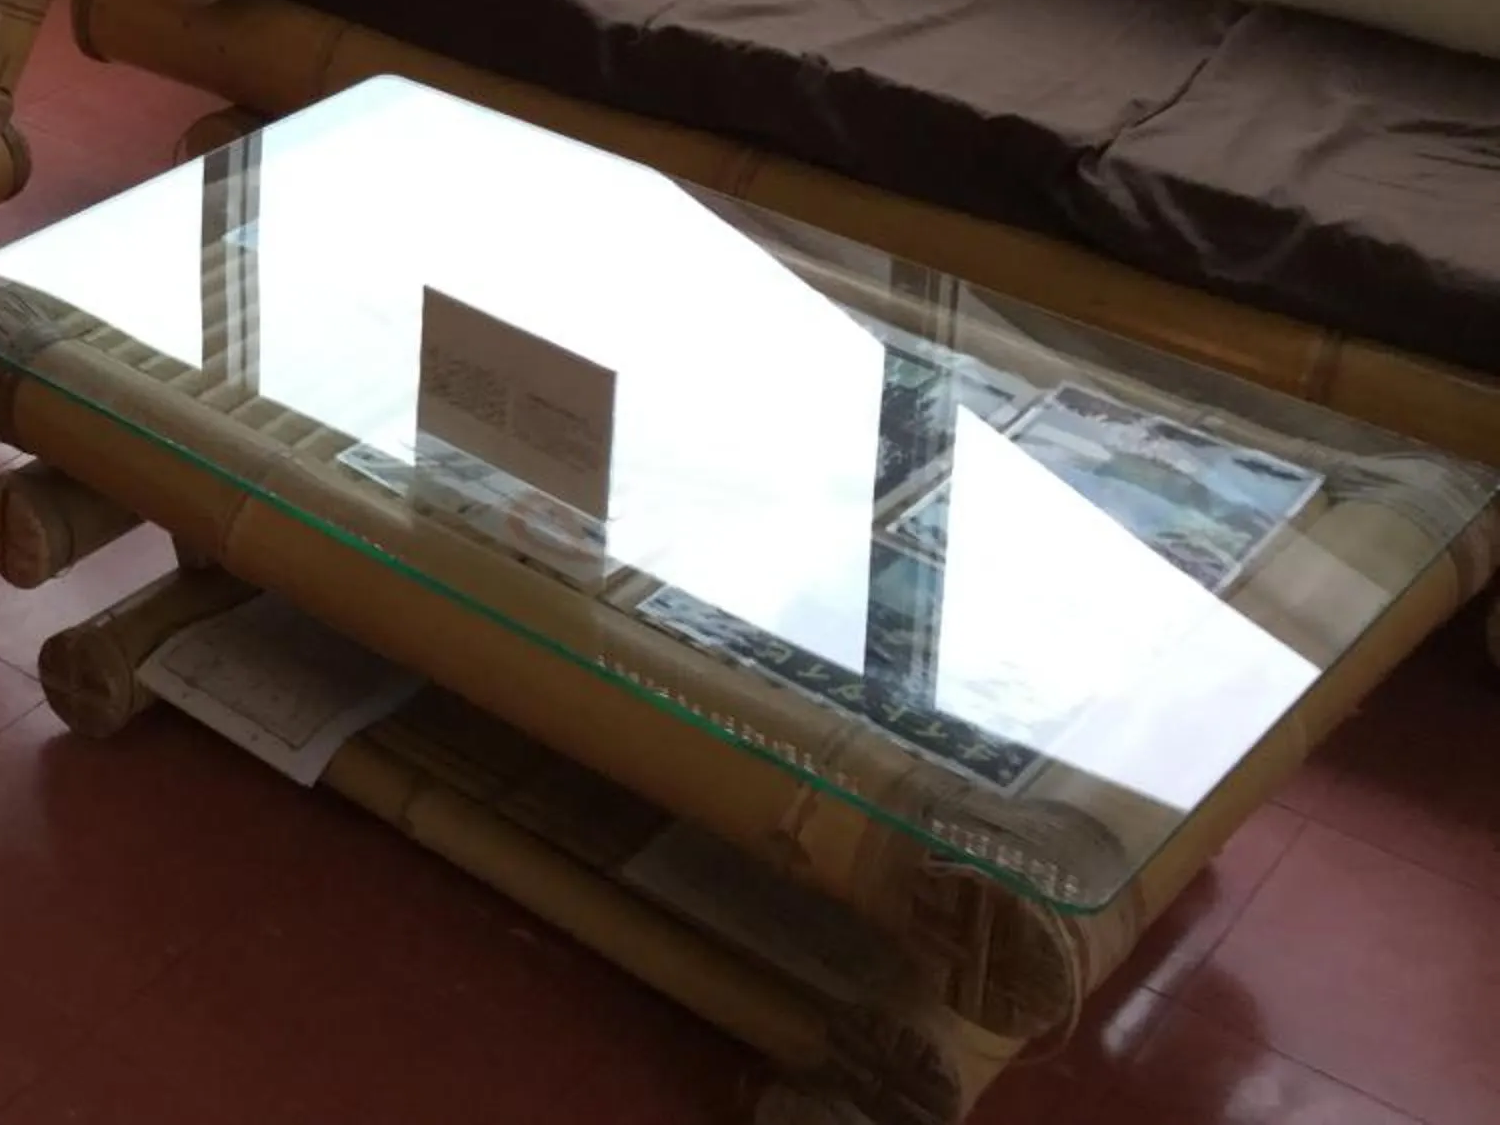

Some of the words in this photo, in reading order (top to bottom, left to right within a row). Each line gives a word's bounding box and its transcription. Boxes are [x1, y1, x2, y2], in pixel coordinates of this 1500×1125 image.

[722, 625, 999, 763] ナイトダイビ
